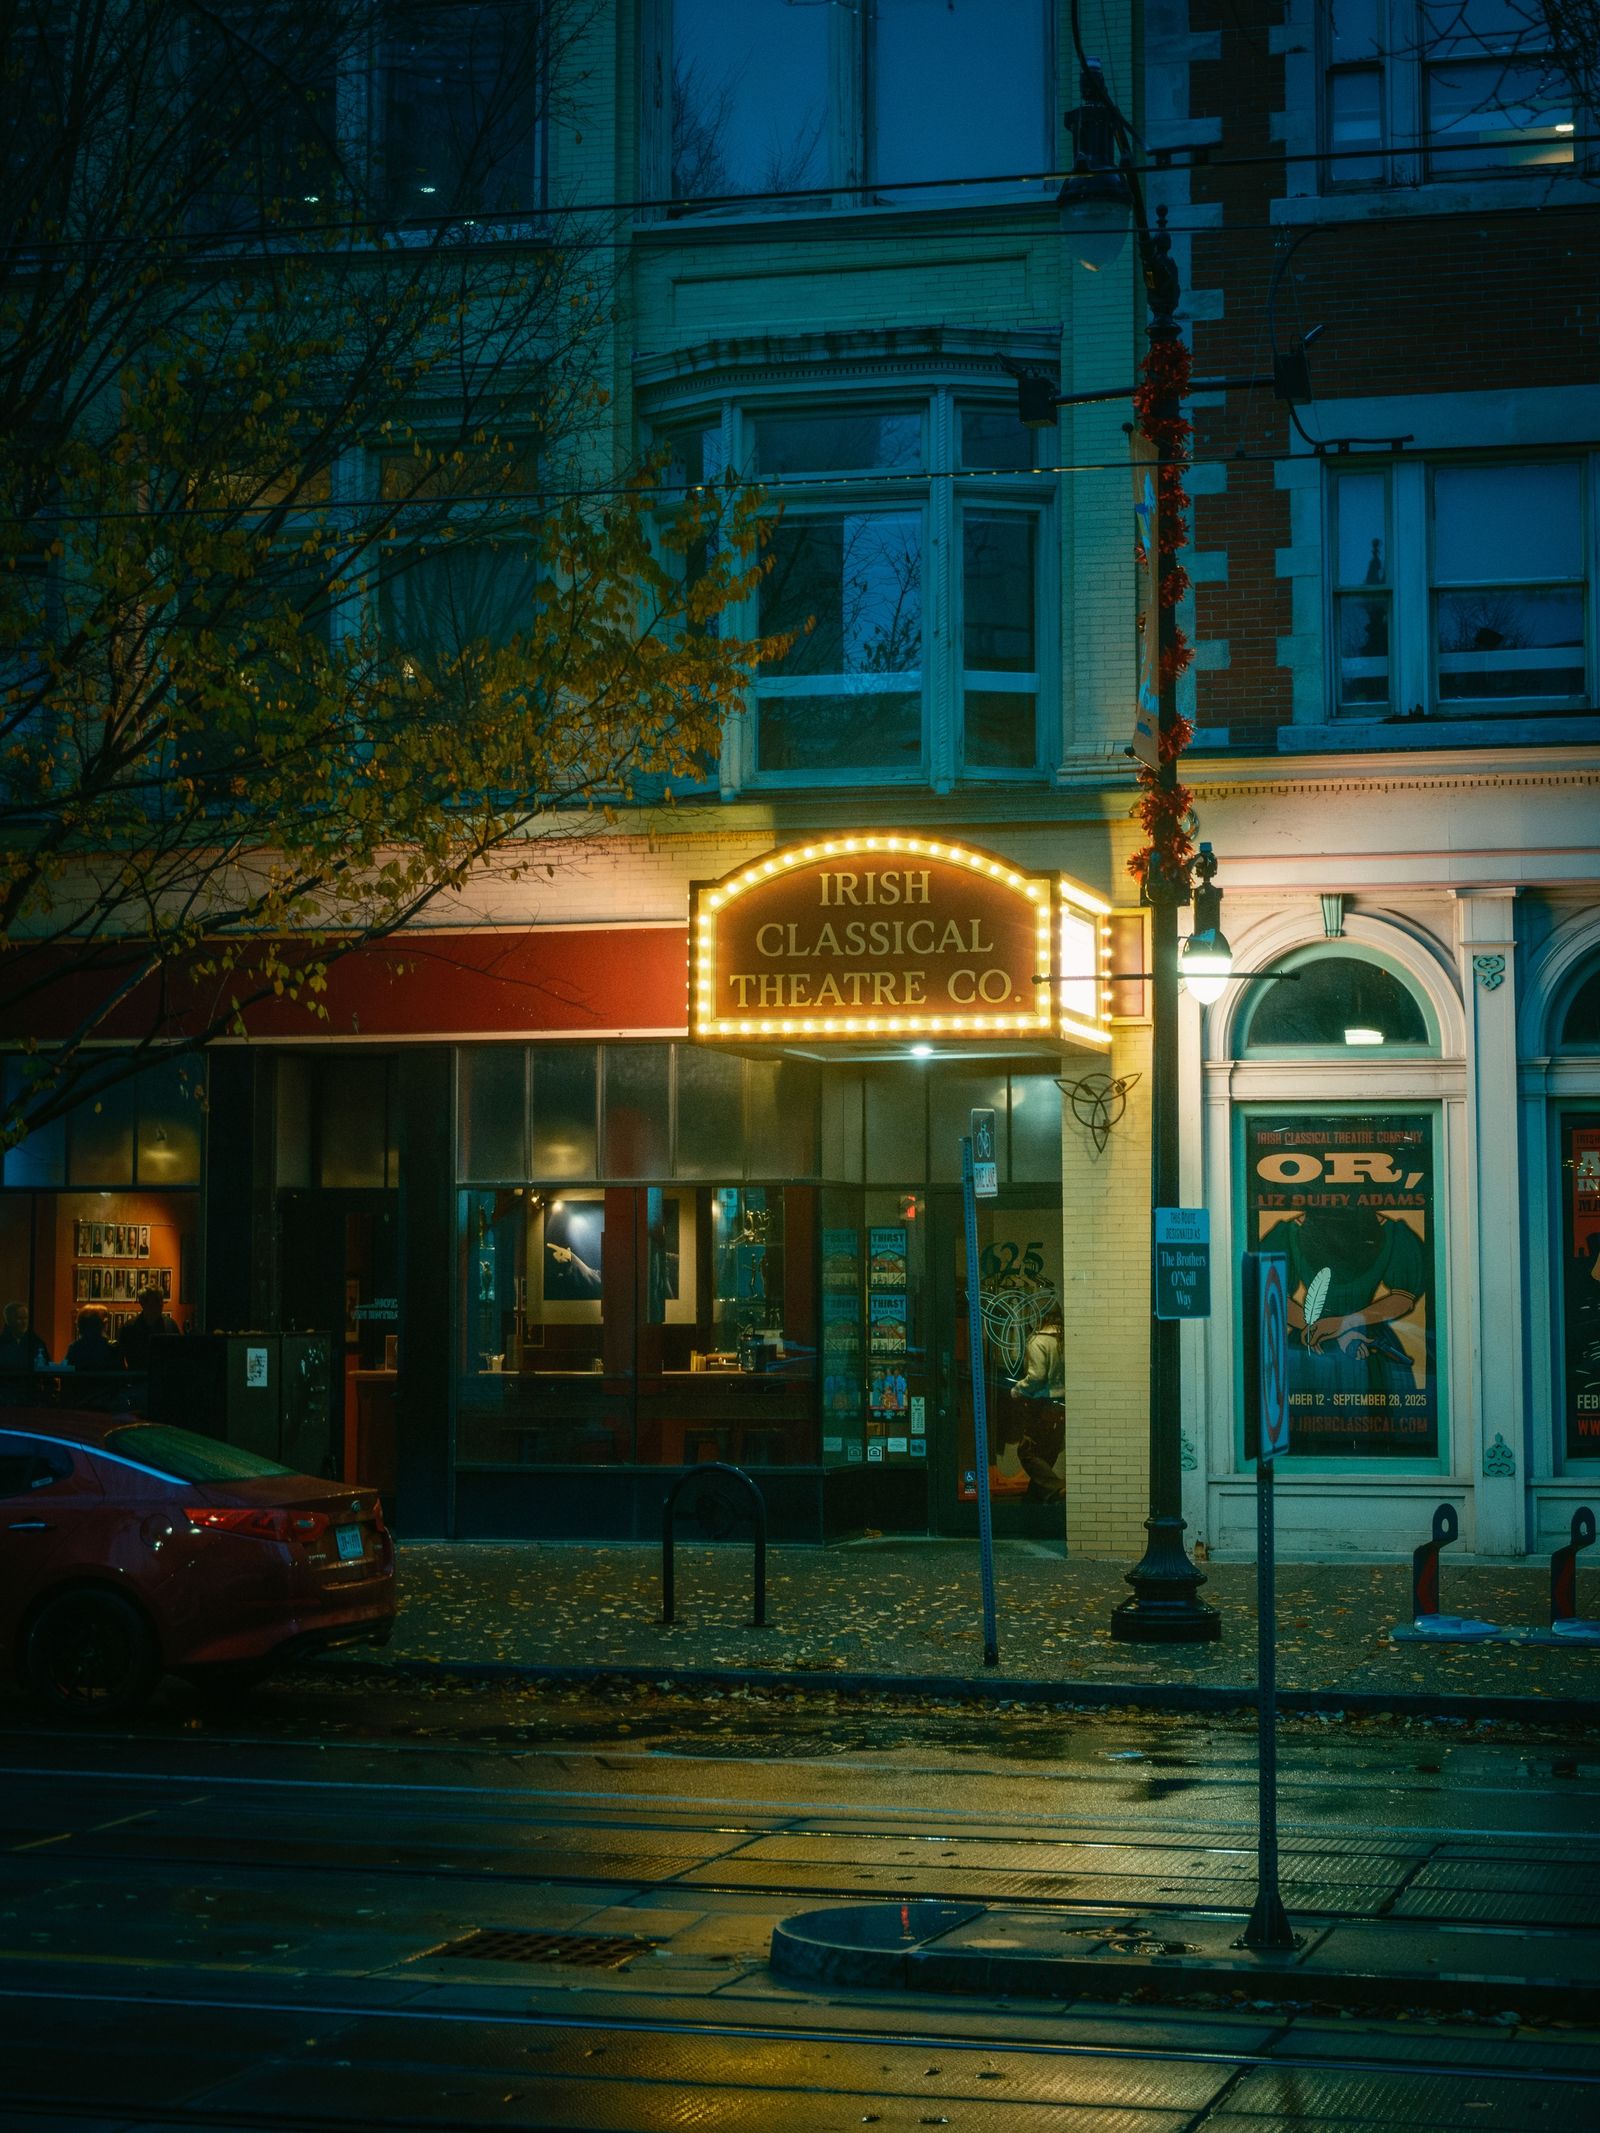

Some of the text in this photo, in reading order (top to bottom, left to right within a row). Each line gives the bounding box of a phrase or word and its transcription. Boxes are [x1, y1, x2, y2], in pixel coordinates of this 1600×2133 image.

[819, 870, 931, 906] IRISH
[756, 918, 994, 957] CLASSICAL
[729, 968, 1022, 1008] THEATRE CO.
[1257, 1132, 1281, 1145] IRISH
[1284, 1132, 1330, 1145] CLASSICAL
[1334, 1132, 1374, 1145] THEATRE
[1257, 1153, 1424, 1189] OR,
[1258, 1193, 1425, 1206] LIZ DUFFY ADAMS
[1161, 1251, 1206, 1267] The Brothers
[1171, 1271, 1197, 1286] O'Neill
[872, 1299, 904, 1308] THIRST
[1176, 1291, 1192, 1310] Way
[1315, 1394, 1324, 1406] 12
[1333, 1394, 1386, 1406] SEPTEMBER
[1405, 1394, 1427, 1406] 2025
